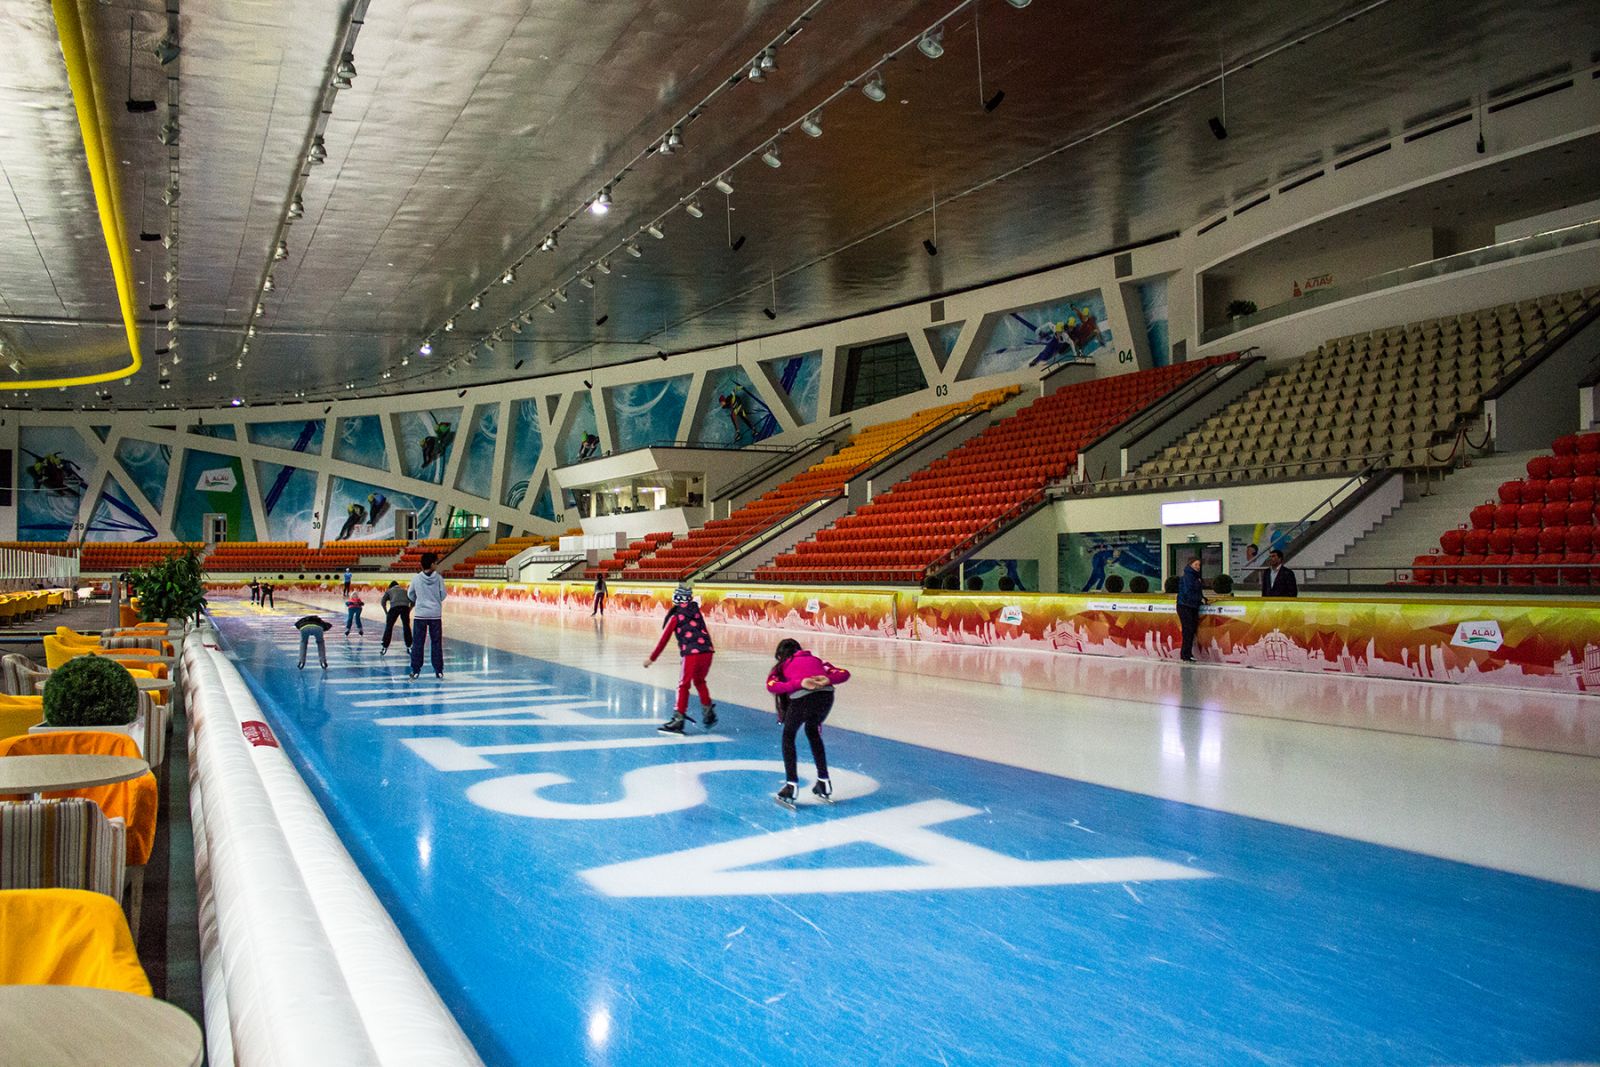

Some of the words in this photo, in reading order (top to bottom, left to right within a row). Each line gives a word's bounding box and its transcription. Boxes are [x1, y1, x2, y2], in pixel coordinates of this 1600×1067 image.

[1118, 348, 1133, 364] 04
[936, 384, 948, 397] 03
[433, 517, 442, 526] 31
[556, 513, 565, 523] 01
[74, 522, 85, 530] 29
[312, 521, 321, 530] 30
[1471, 629, 1496, 637] ALAU
